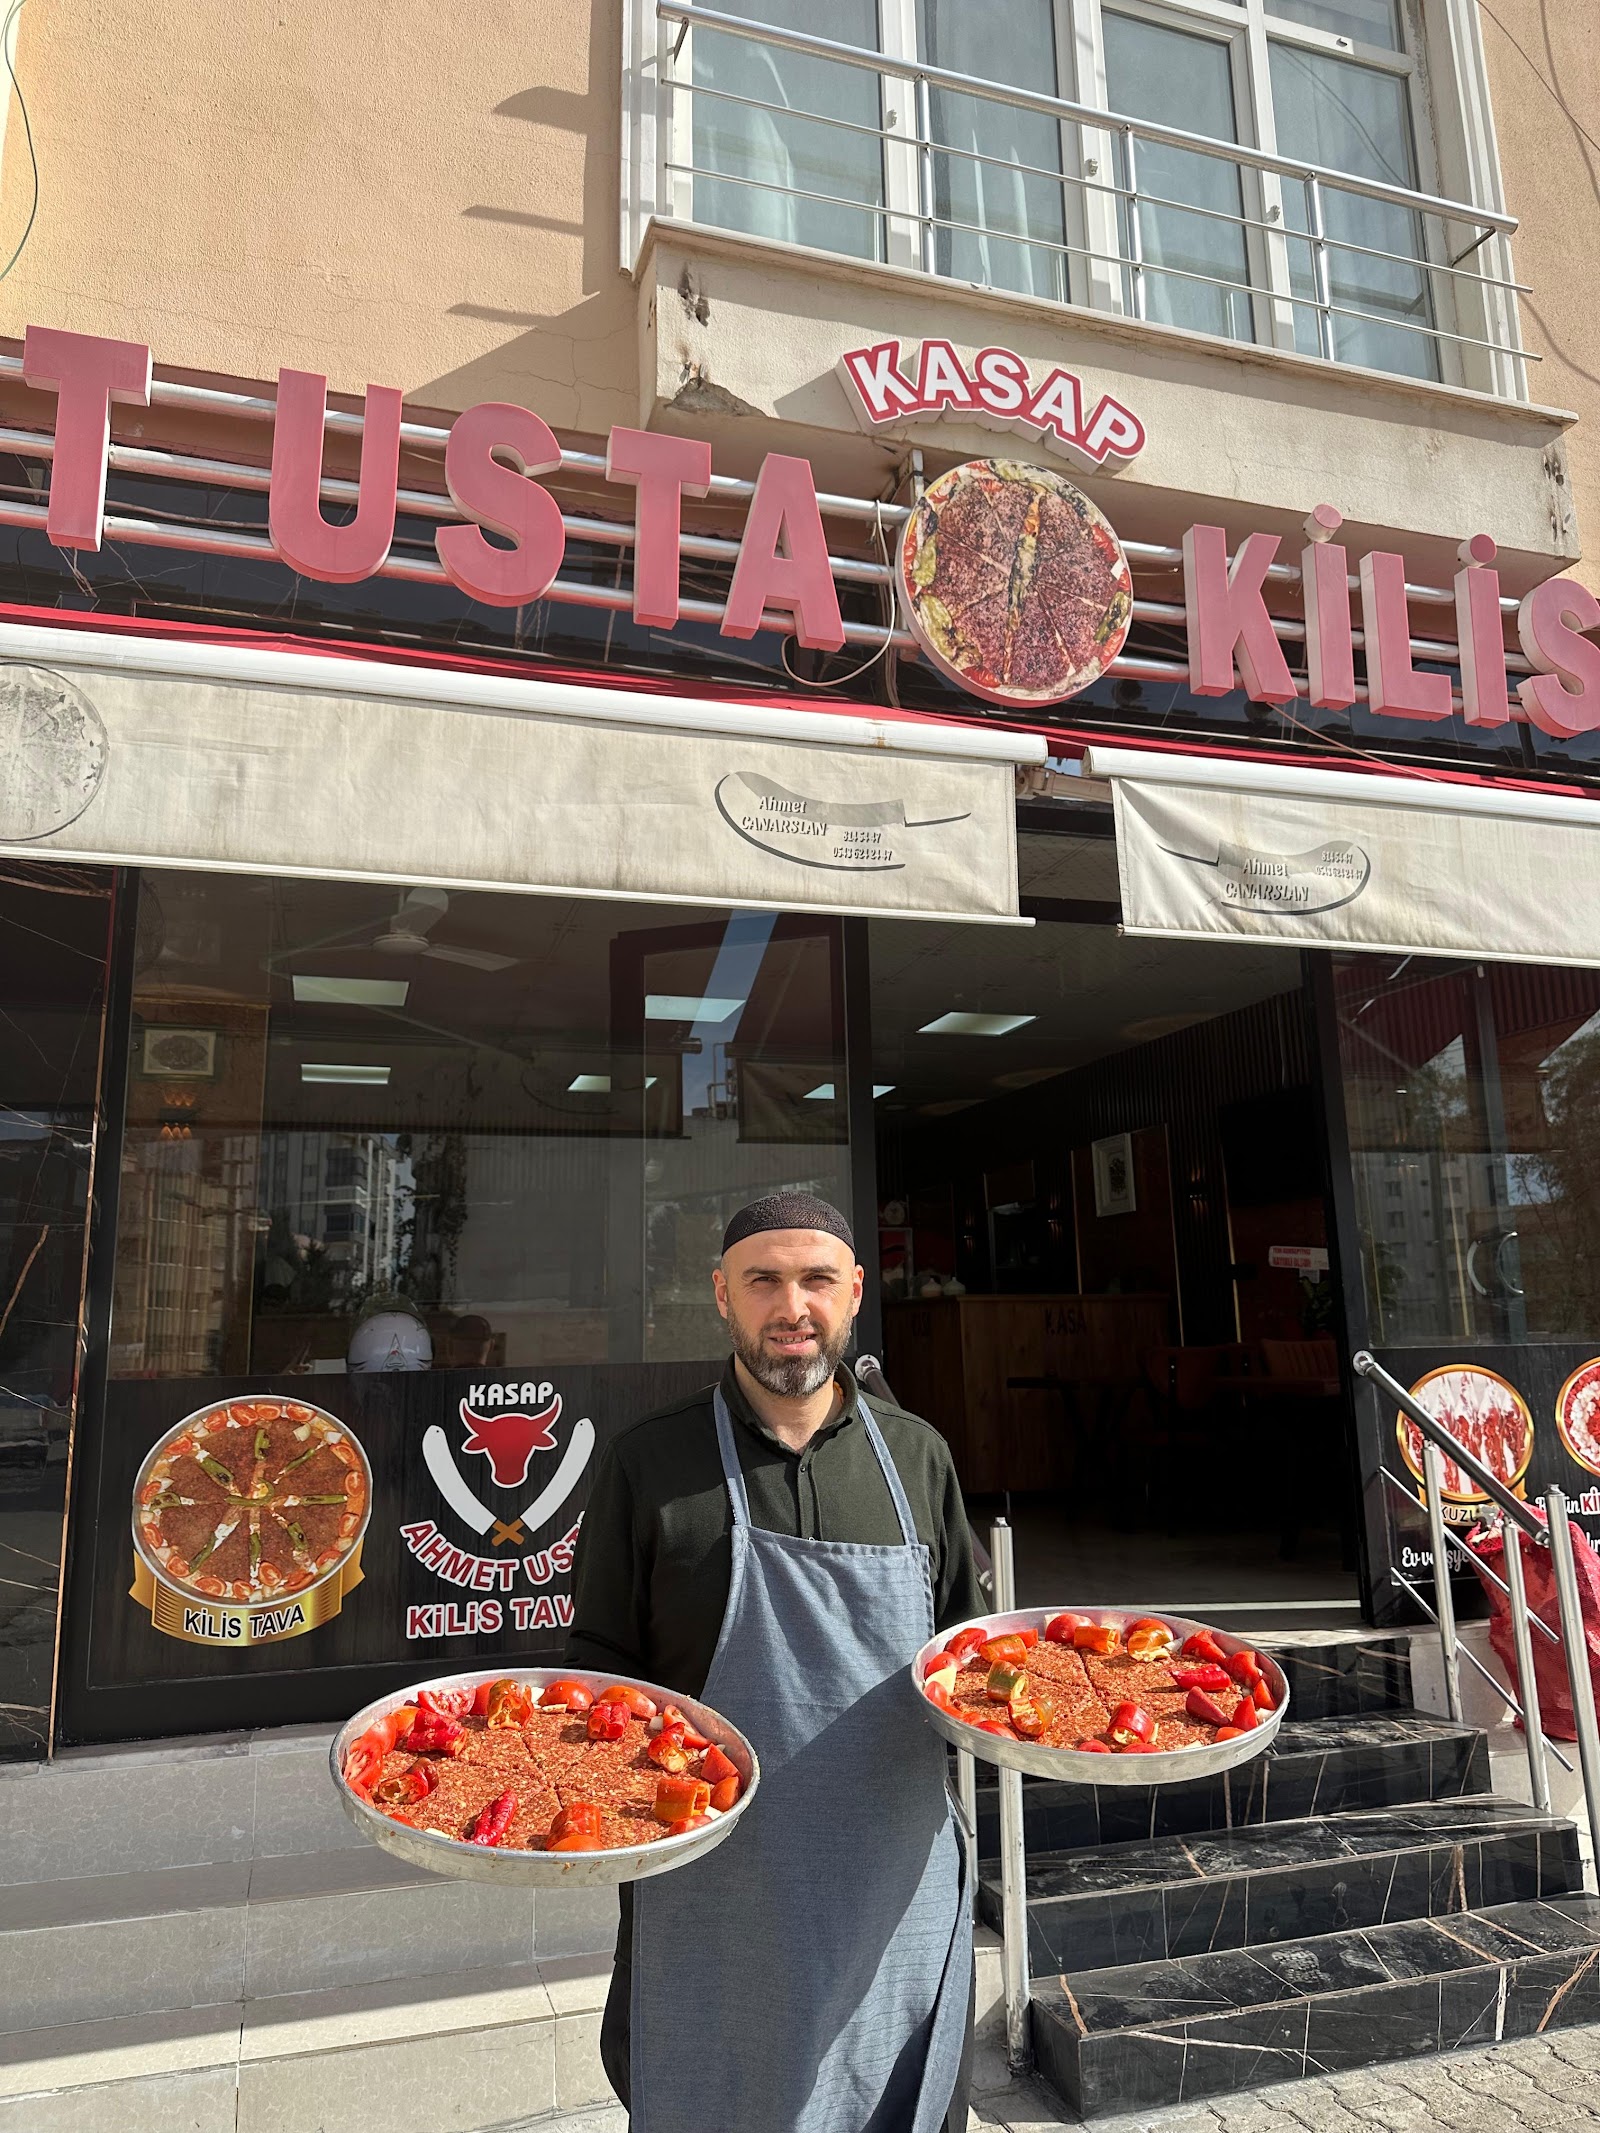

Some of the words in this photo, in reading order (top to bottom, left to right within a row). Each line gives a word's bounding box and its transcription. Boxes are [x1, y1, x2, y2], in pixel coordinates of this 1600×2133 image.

[845, 340, 1145, 463] KASAP
[269, 367, 846, 652] USTA
[758, 795, 807, 814] Ahmet
[1242, 857, 1288, 877] Ahmet
[469, 1382, 554, 1407] KASAP
[400, 1520, 519, 1591] AHMET
[184, 1608, 242, 1639] KİLİS
[249, 1603, 305, 1638] TAVA
